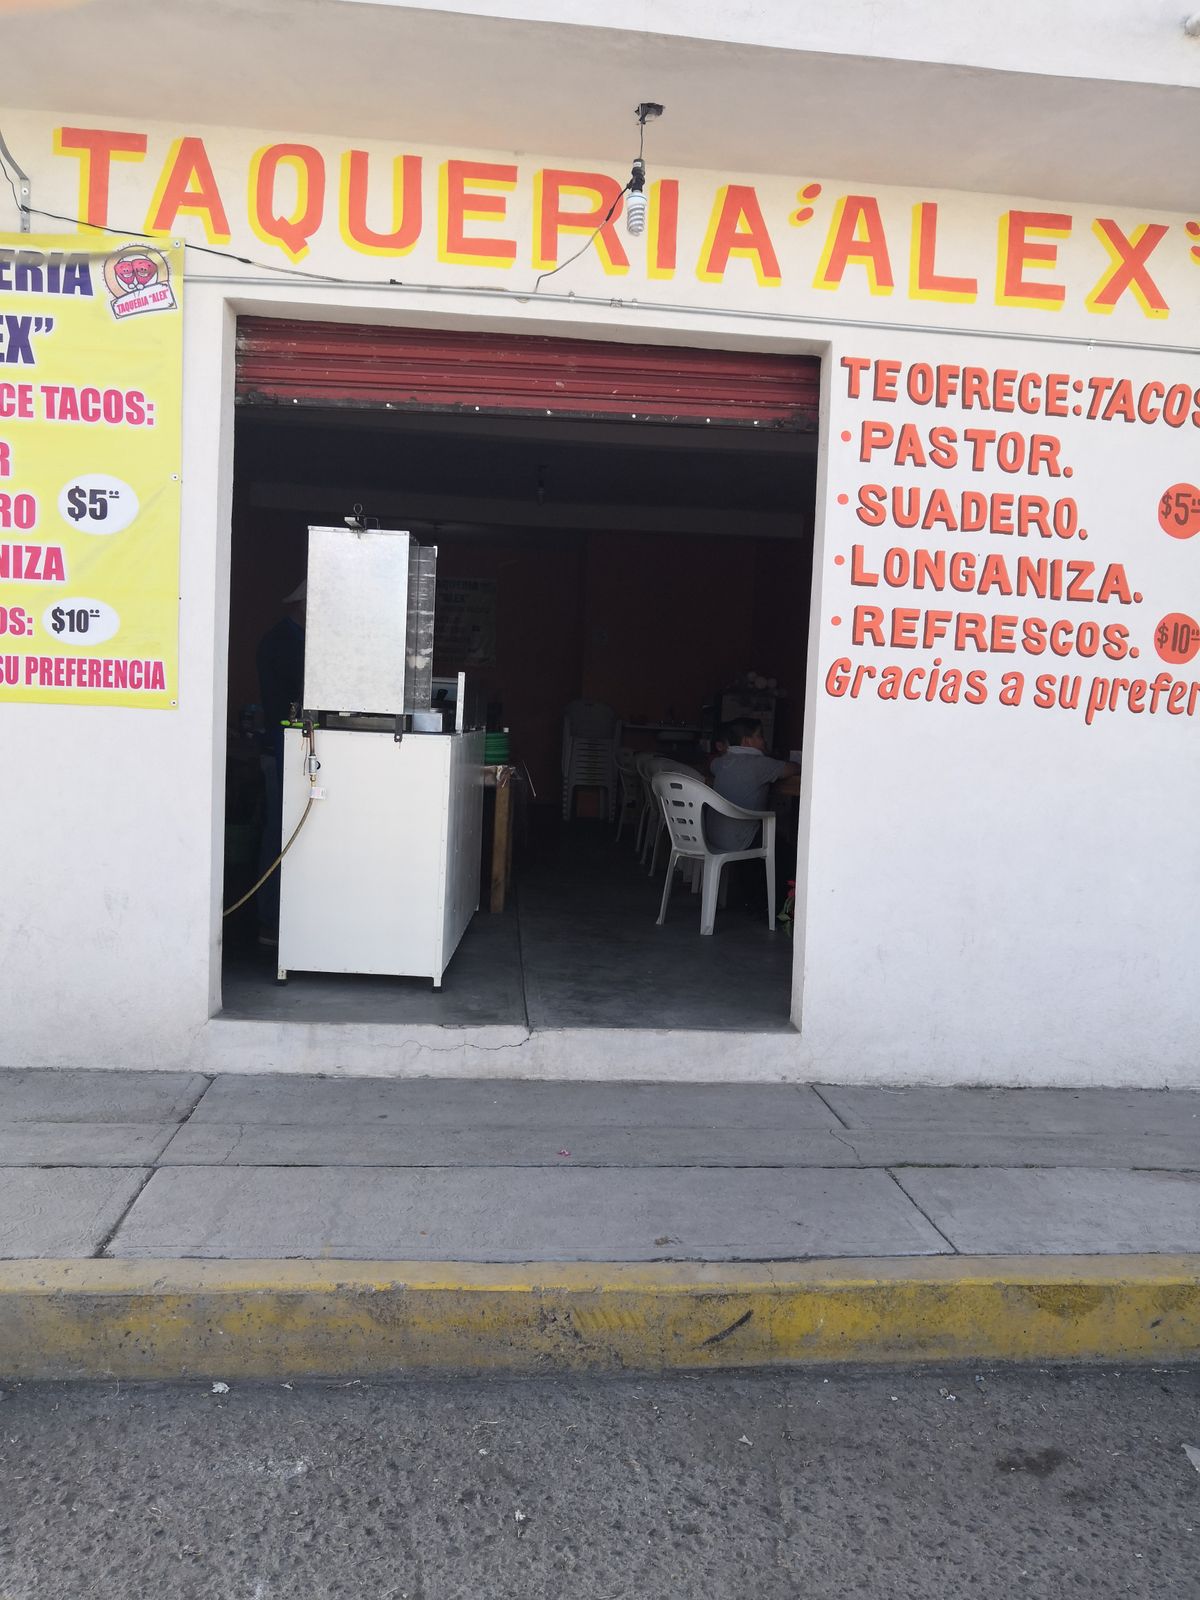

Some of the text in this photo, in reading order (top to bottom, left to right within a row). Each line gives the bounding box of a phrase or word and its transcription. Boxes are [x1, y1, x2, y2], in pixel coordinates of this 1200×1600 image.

[53, 127, 782, 287] TAQUERIA
[117, 296, 149, 314] TAQUERIA
[40, 385, 154, 426] TACOS:
[840, 356, 902, 402] TE
[860, 420, 1074, 478] PASTOR.
[856, 484, 1088, 541] SUADERO.
[851, 544, 1143, 605] LONGANIZA.
[851, 605, 1140, 660] REFRESCOS.
[25, 656, 165, 690] PREFERENCIA
[825, 657, 988, 705] Gracias
[998, 671, 1025, 706] a
[1033, 673, 1083, 710] su
